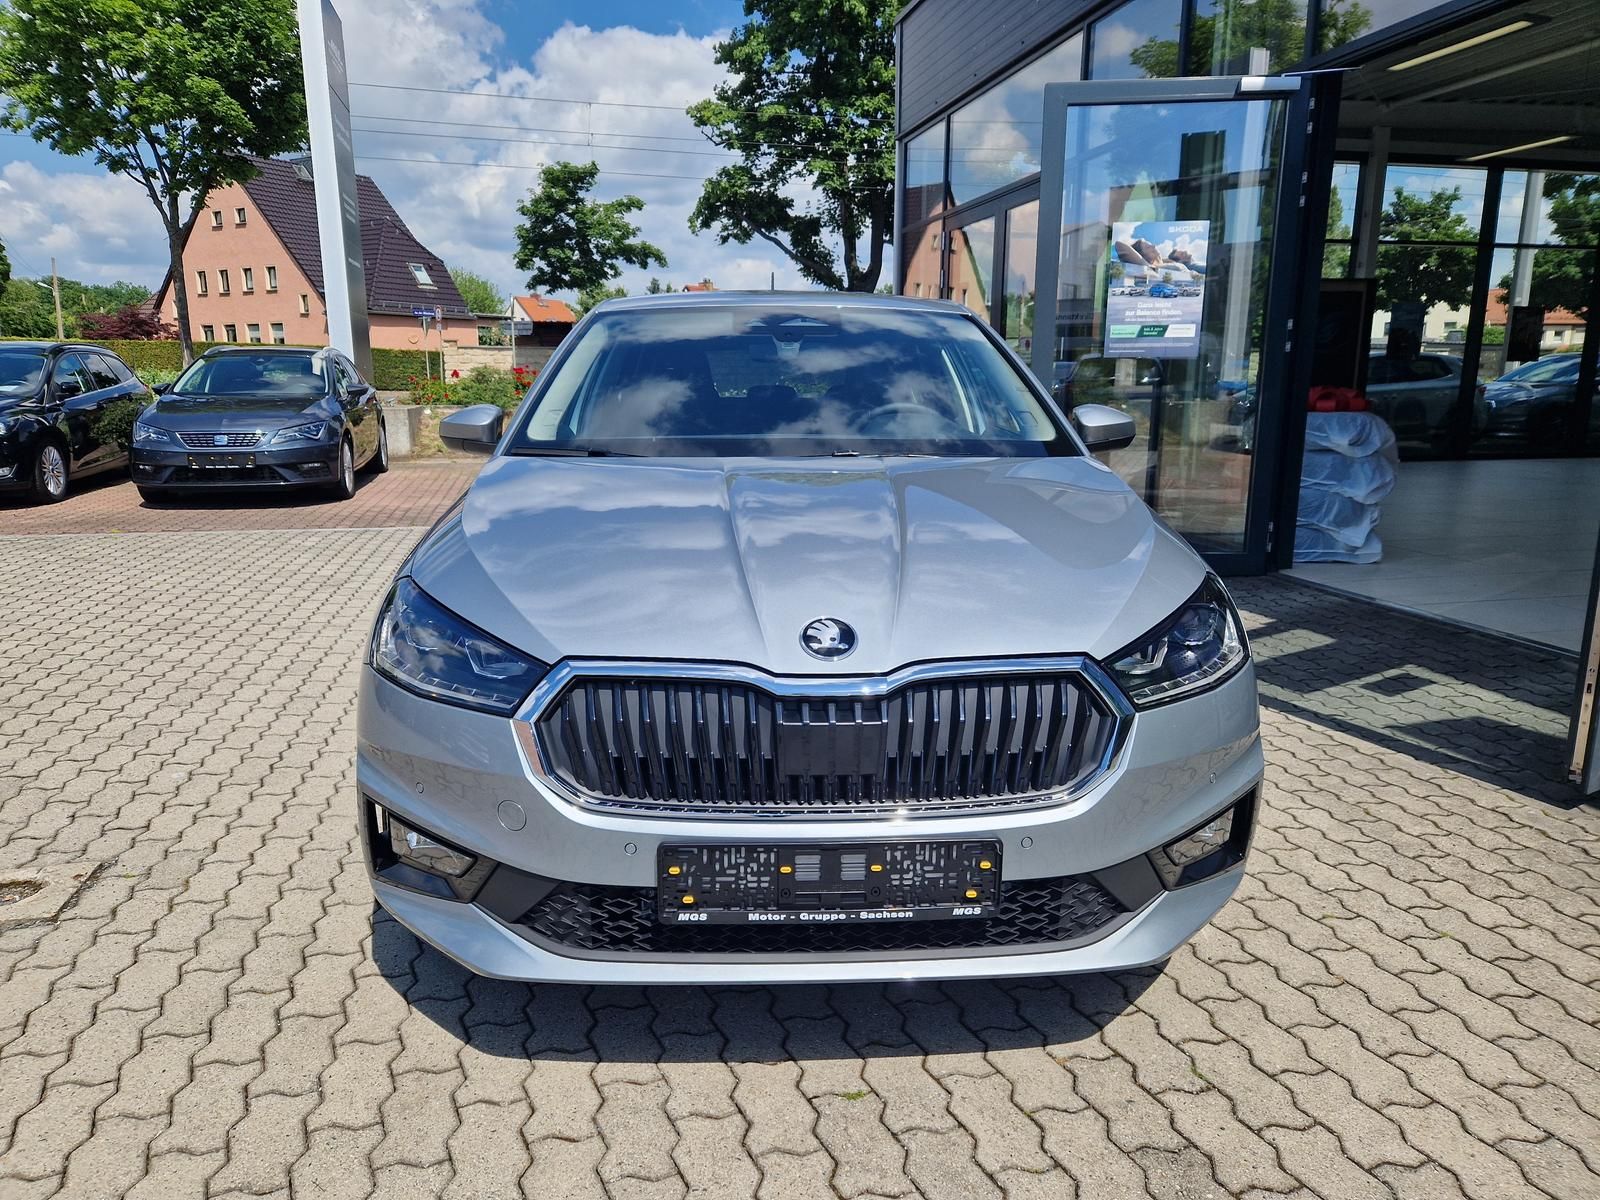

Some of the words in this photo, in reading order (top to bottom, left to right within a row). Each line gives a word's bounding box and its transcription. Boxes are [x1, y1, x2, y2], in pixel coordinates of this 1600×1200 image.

[748, 913, 787, 921] Motor
[800, 912, 847, 921] Gruppe
[859, 911, 914, 919] Sachsen
[952, 907, 982, 916] MGS
[678, 913, 708, 921] MGS
